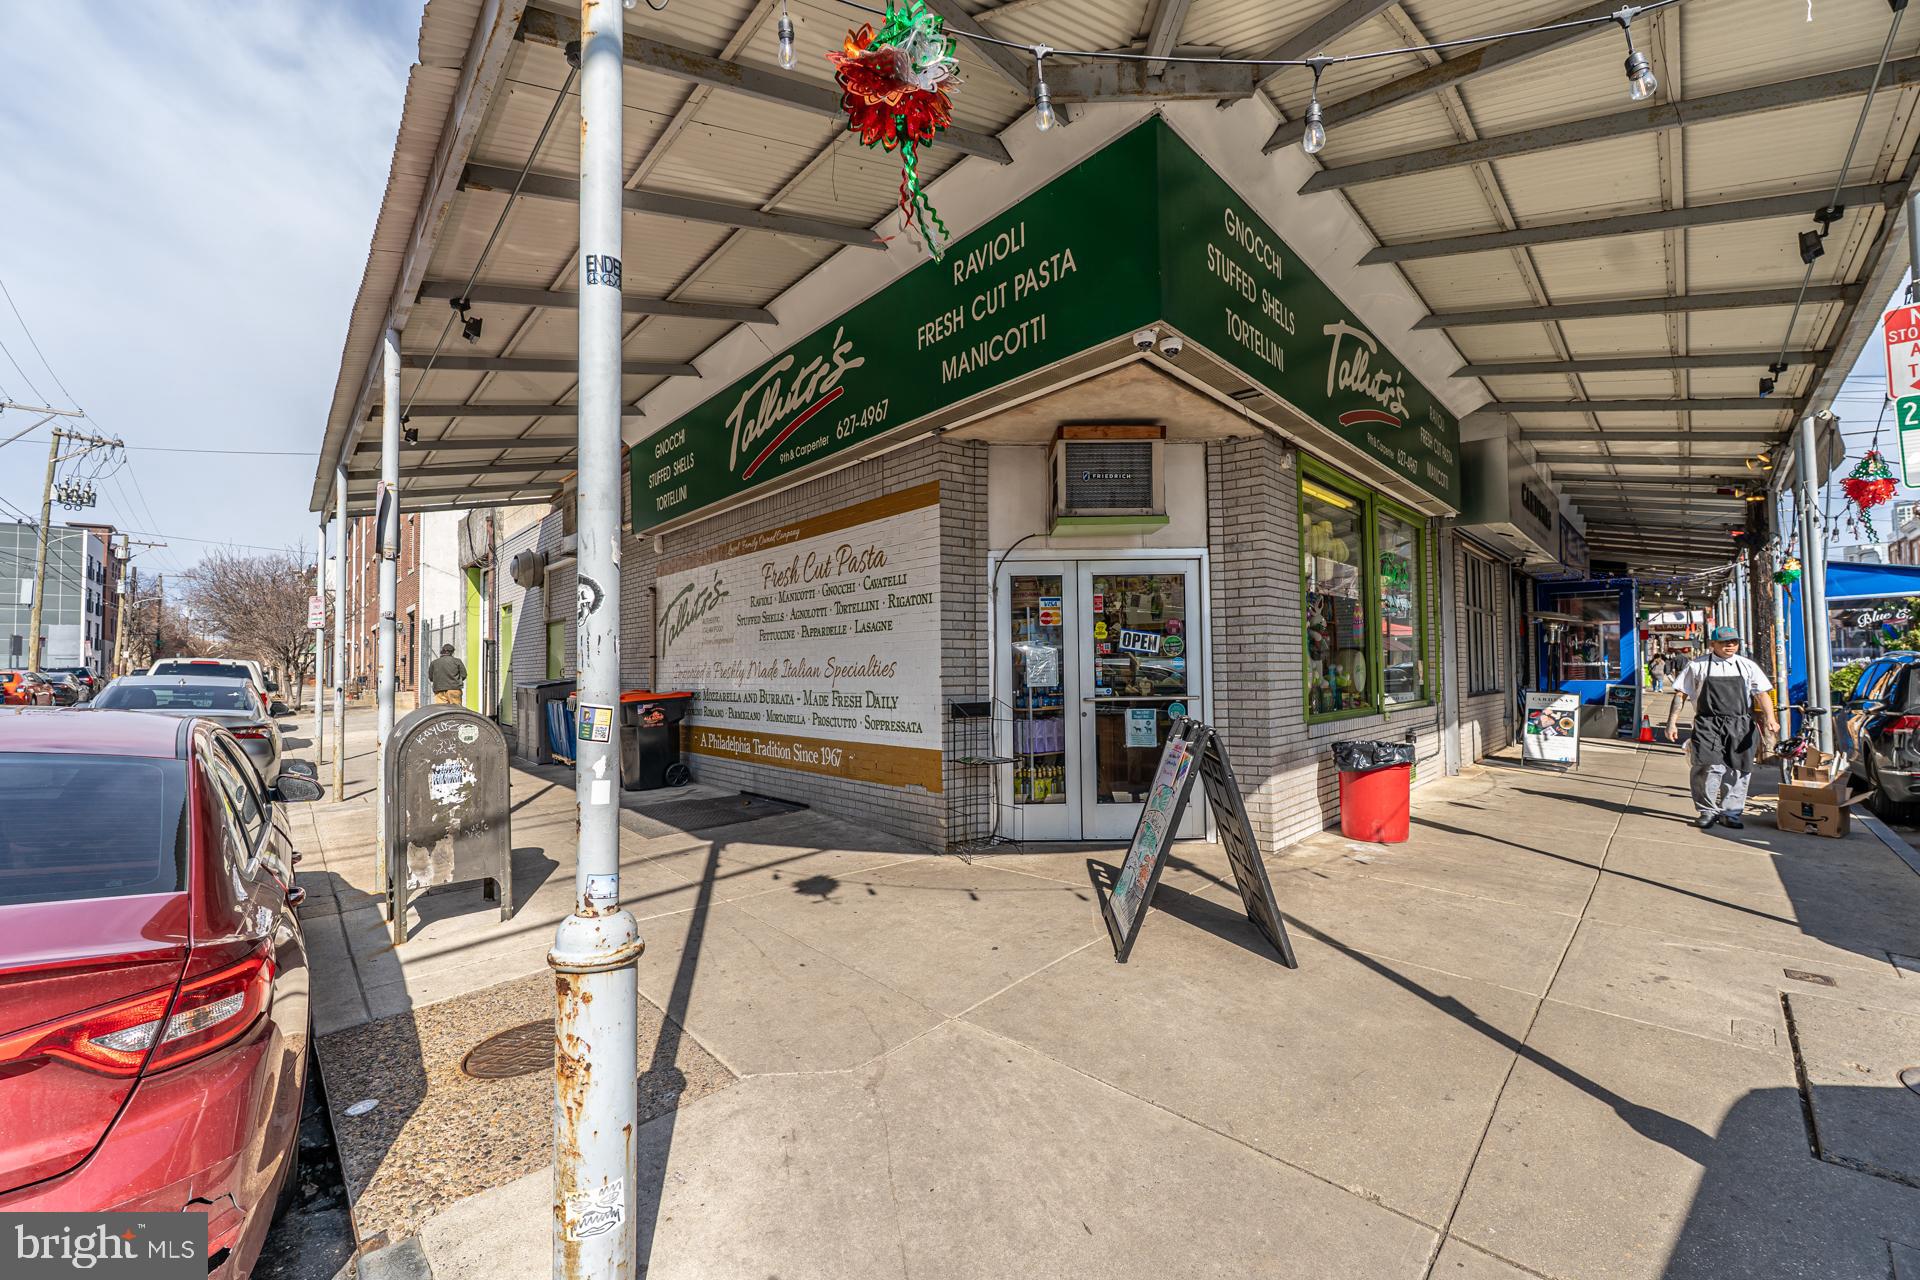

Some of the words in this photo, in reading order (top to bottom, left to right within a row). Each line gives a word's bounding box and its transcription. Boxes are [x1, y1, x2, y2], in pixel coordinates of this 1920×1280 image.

[953, 222, 1025, 286] RAVIOLI
[1224, 207, 1282, 280] GNOCCHI
[917, 305, 964, 351] FRESH
[971, 282, 1007, 321] CUT
[1014, 248, 1077, 301] PASTA
[1207, 243, 1257, 304] STUFFED
[1262, 288, 1295, 336] SHELLS
[942, 314, 1046, 384] MANICOTTI
[1225, 307, 1284, 373] TORTELLINI
[655, 428, 686, 459] GNOCCHI
[795, 435, 830, 459] Carpenter
[836, 398, 889, 440] 627-4967
[648, 464, 671, 489] STUFFED
[673, 452, 695, 477] SHELLS
[656, 484, 688, 512] TORTELLINI
[761, 555, 800, 590] Fresh
[803, 551, 832, 583] Cut
[835, 543, 888, 577] Pasta
[778, 590, 816, 604] MANICOTTI
[822, 582, 856, 597] GNOCCHI
[863, 573, 908, 591] CAVATELLI
[736, 613, 761, 627] STUFFED
[762, 609, 785, 624] SHELLS
[790, 606, 828, 621] AGNOLOTTI
[833, 598, 880, 616] TORTELLINI
[887, 592, 934, 609] RIGATONI
[759, 629, 796, 642] FETTUCCINE
[801, 622, 847, 638] PAPPARDELLE
[854, 618, 893, 634] LASAGNE
[1122, 631, 1158, 651] OPEN
[747, 660, 779, 680] Made
[781, 658, 821, 678] Italian
[824, 654, 898, 688] Specialties
[743, 692, 758, 704] AND
[759, 689, 795, 706] BURRATA
[803, 690, 829, 706] MADE
[832, 690, 862, 708] FRESH
[865, 690, 899, 711] DAILY
[765, 709, 806, 724] MORTADELLA
[812, 712, 857, 729] PROSCIUTTO
[864, 715, 923, 734] SOPPRESSATA
[700, 733, 708, 747] A
[707, 733, 751, 755] Philadelphia
[752, 739, 791, 760] Tradition
[793, 743, 819, 764] Since
[820, 747, 842, 767] 1967
